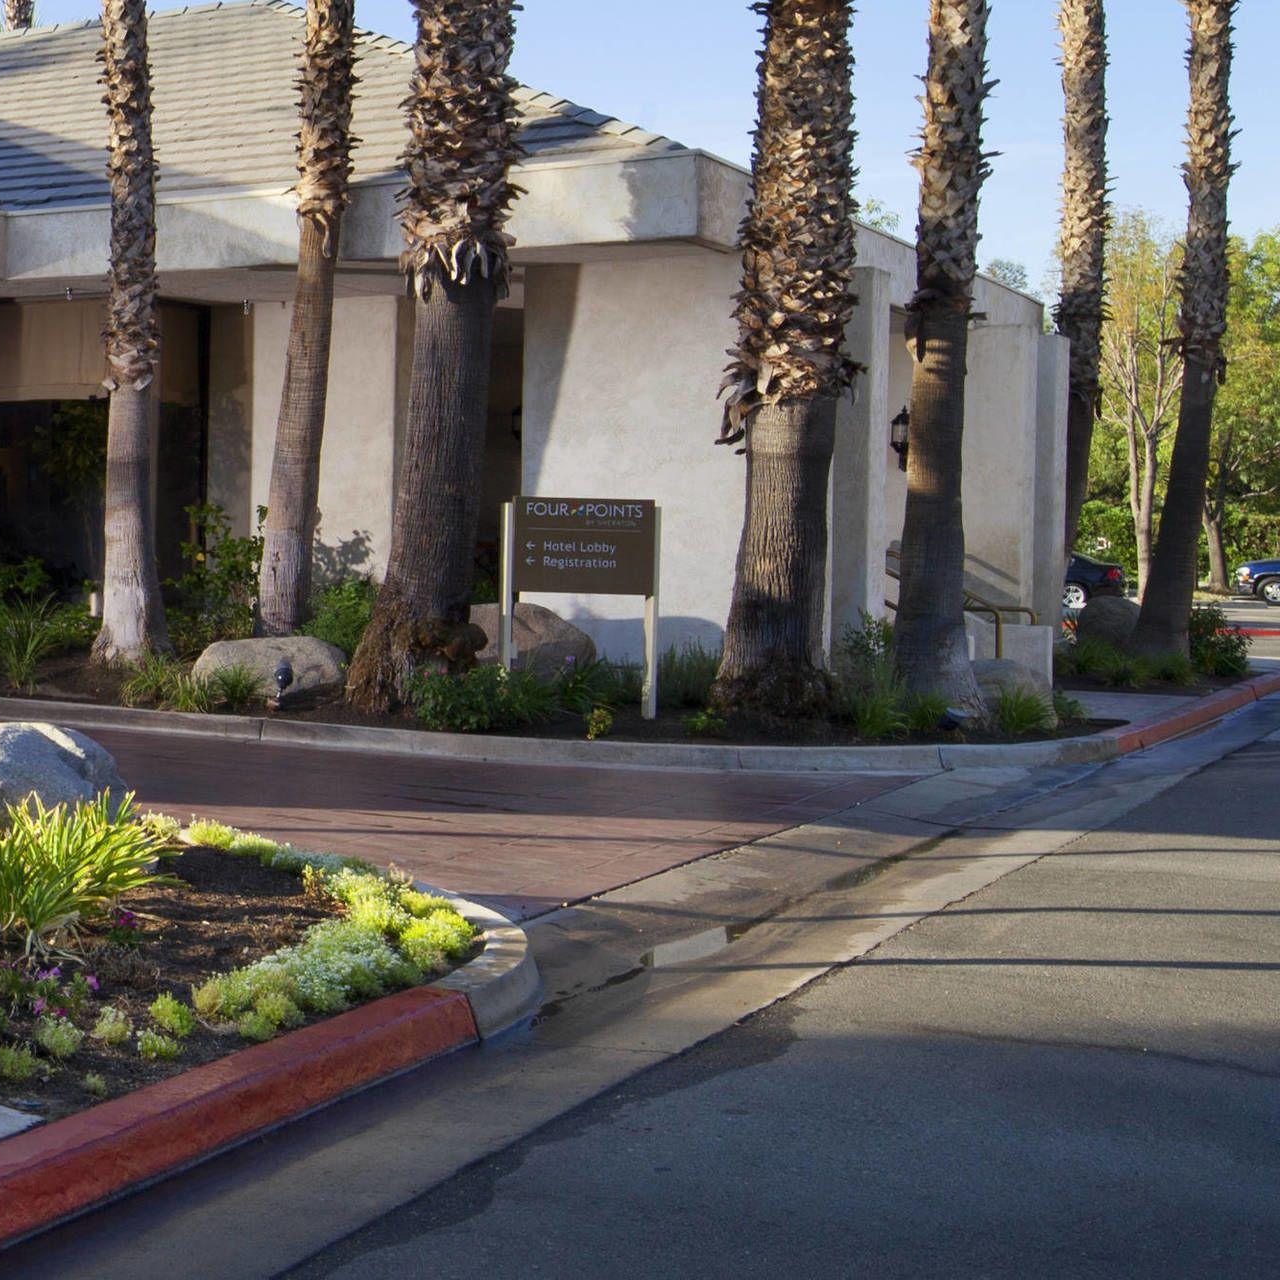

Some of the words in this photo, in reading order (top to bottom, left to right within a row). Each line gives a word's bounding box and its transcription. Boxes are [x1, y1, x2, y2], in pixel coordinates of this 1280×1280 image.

[526, 502, 569, 516] FOUR
[585, 503, 643, 518] POINTS
[543, 540, 576, 553] Hotel
[580, 541, 616, 555] Lobby
[543, 556, 617, 570] Registration
